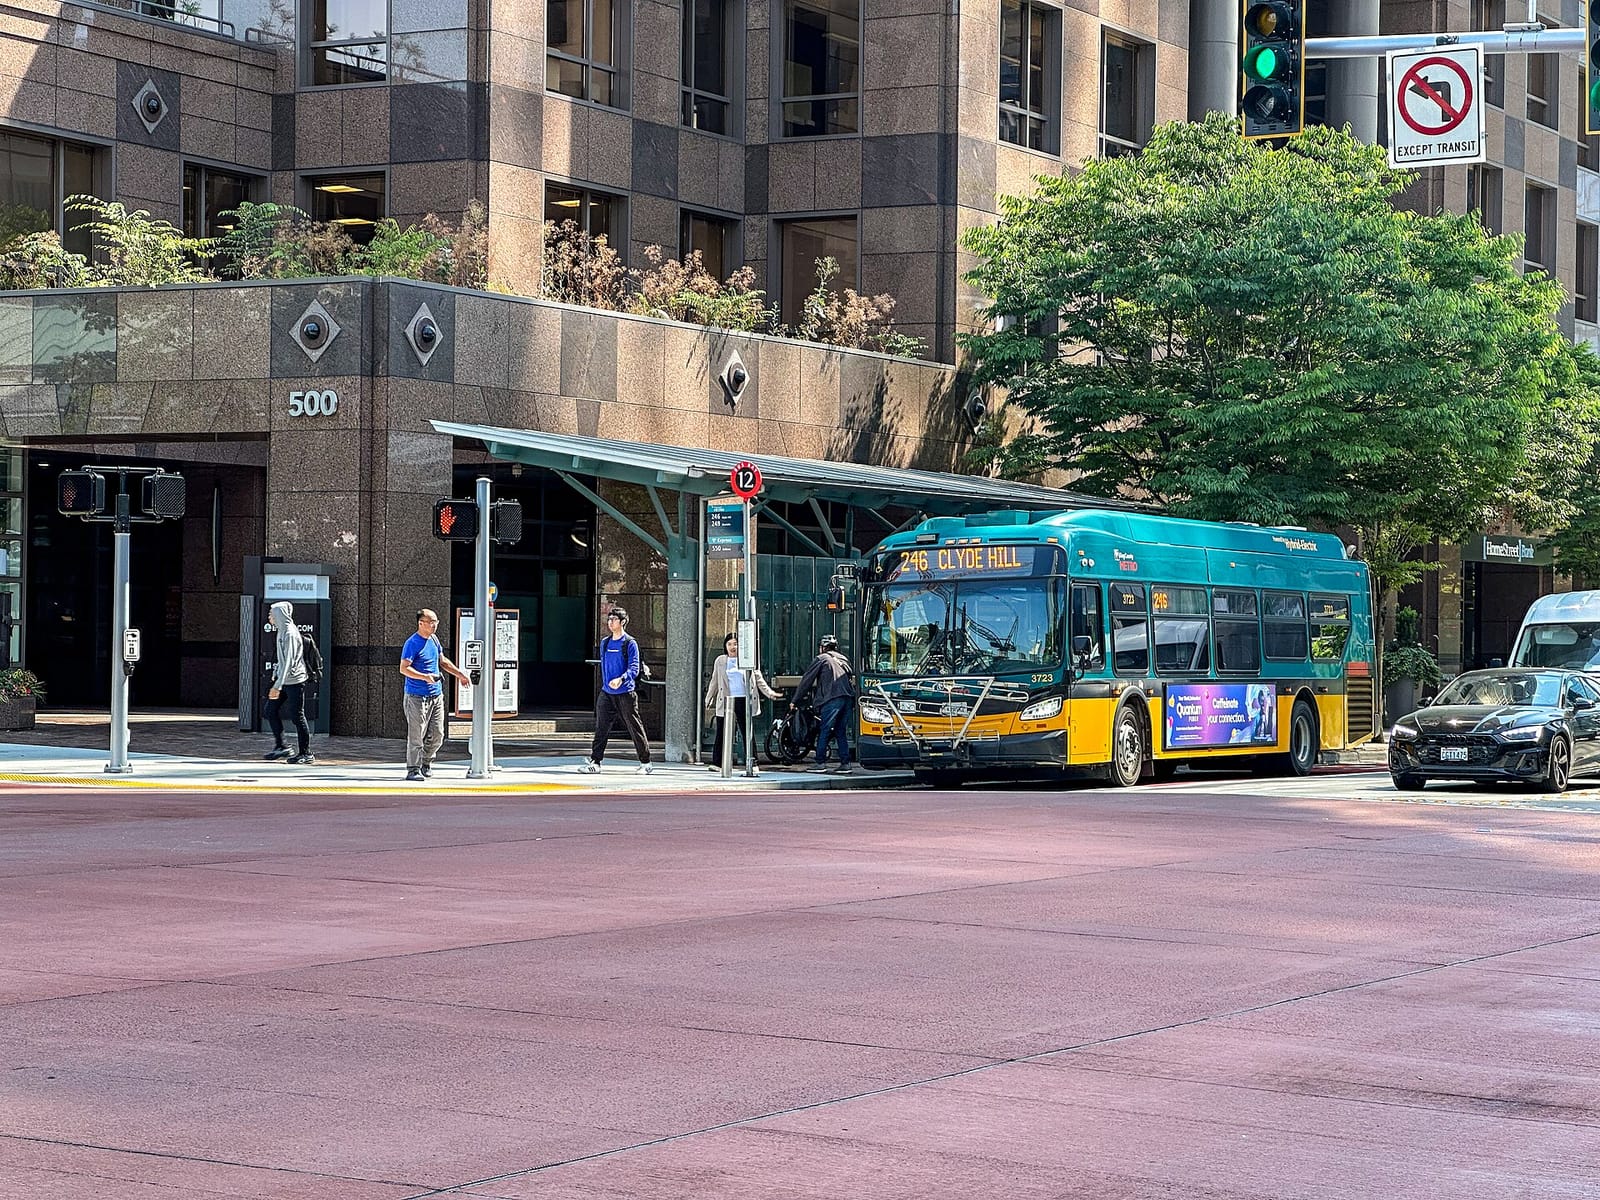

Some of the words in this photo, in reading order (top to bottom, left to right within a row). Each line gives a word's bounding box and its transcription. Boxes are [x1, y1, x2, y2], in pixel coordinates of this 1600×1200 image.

[1397, 144, 1433, 157] EXCEPT
[1437, 141, 1476, 153] TRANSIT
[288, 390, 338, 417] 500
[738, 472, 754, 489] 12
[900, 550, 928, 572] 246
[938, 546, 984, 570] CLYDE
[988, 546, 1022, 568] HILL
[1521, 544, 1535, 559] Bank
[1122, 593, 1135, 605] 3723
[1153, 592, 1168, 609] 246
[1031, 673, 1053, 683] 3723
[1176, 702, 1203, 719] Quantum
[1212, 697, 1239, 709] Caffeinate
[1207, 714, 1219, 726] your
[1219, 712, 1245, 723] connection.
